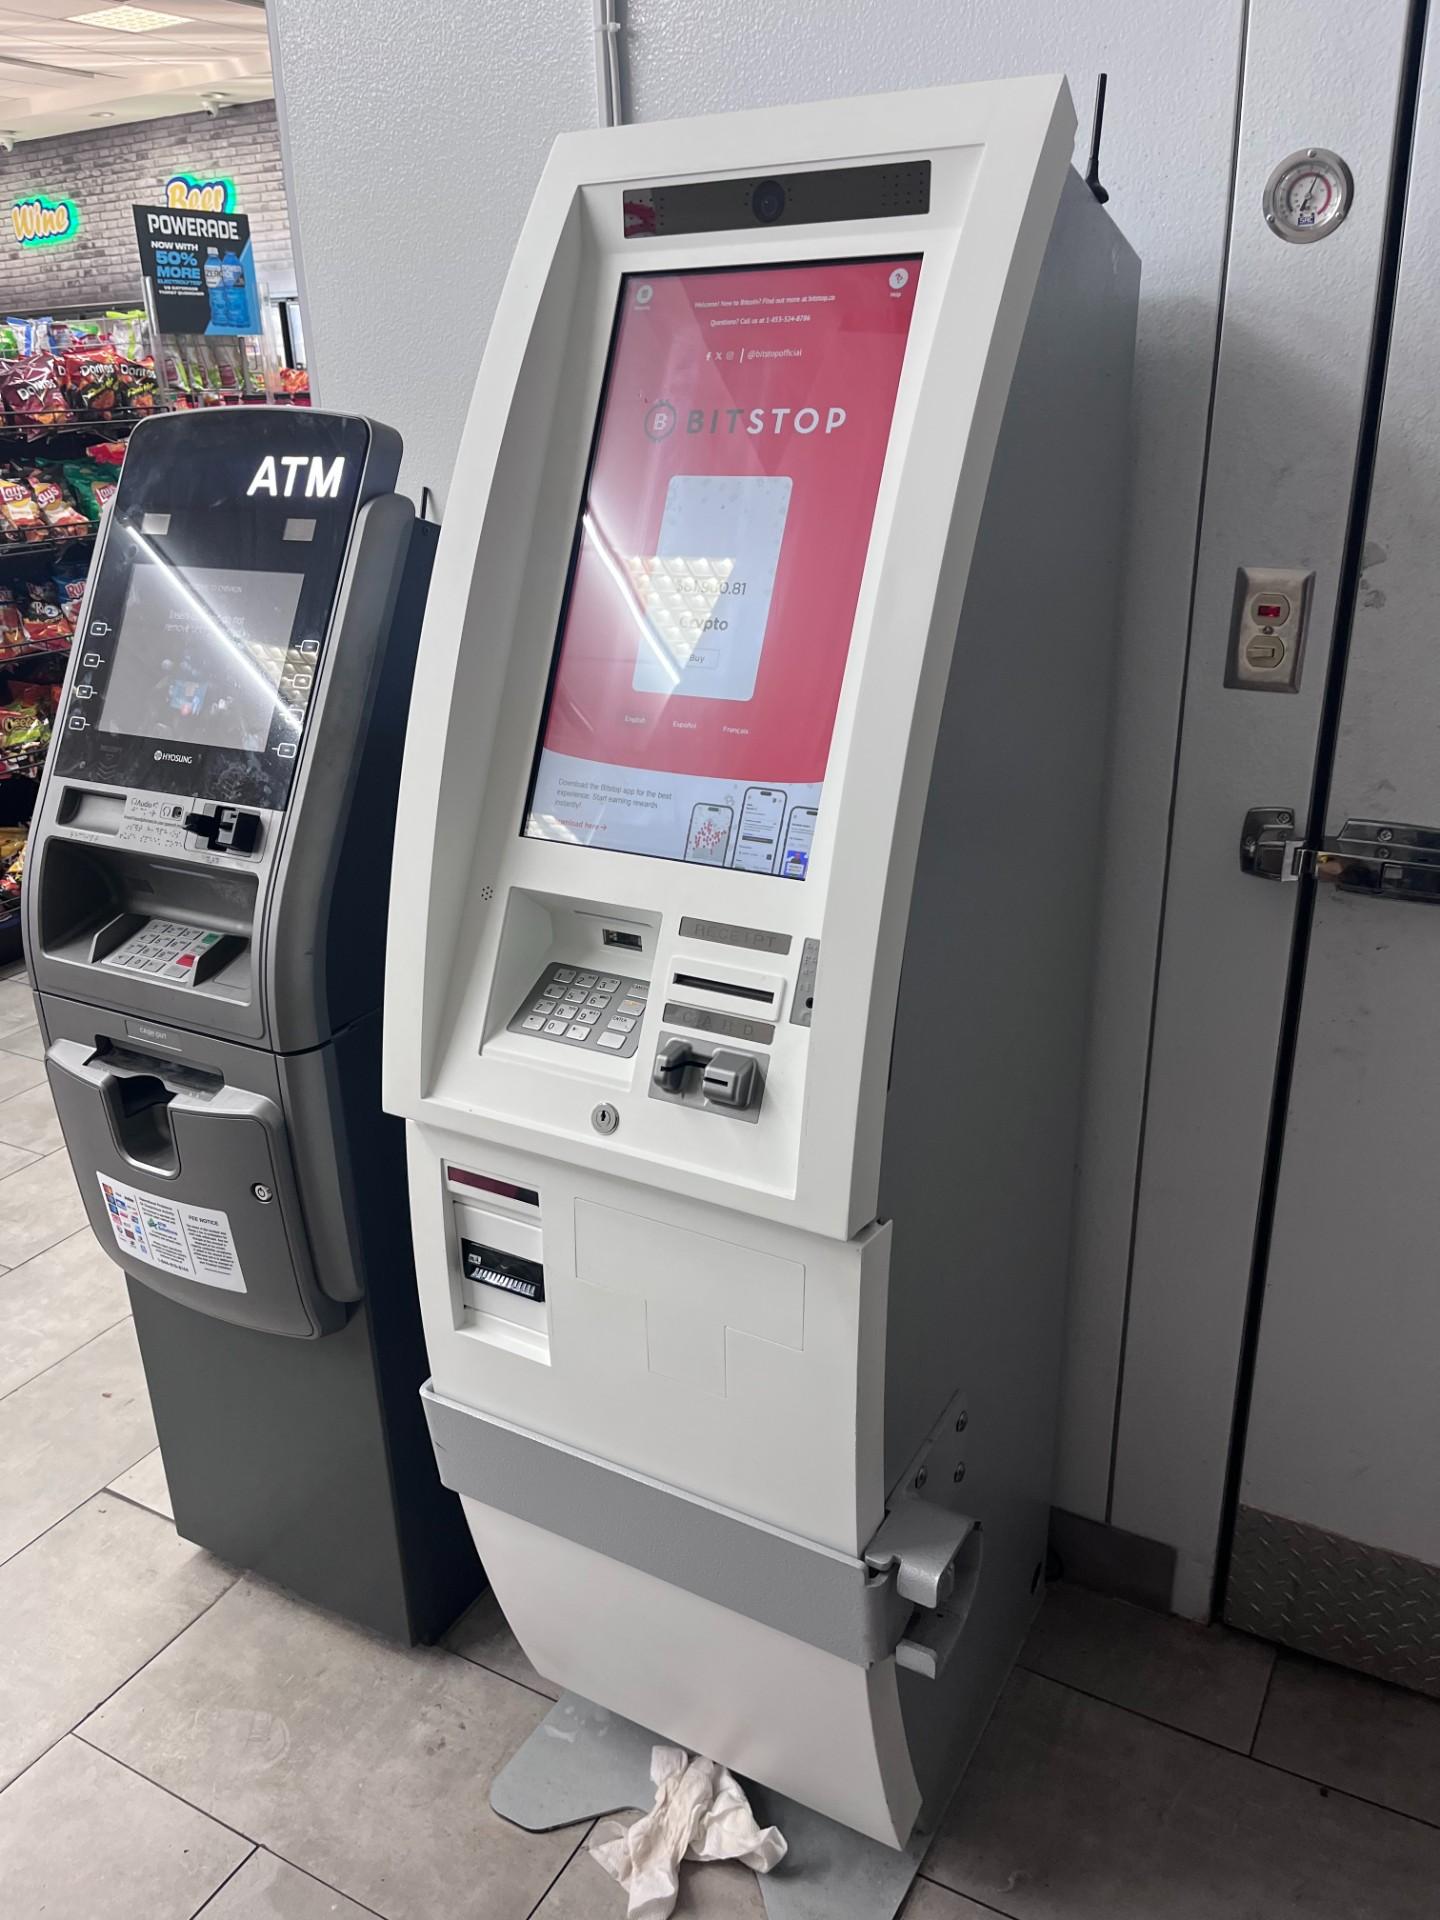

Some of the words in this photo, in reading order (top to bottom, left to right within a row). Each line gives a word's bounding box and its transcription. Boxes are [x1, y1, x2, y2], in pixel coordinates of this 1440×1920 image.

[167, 181, 224, 212] Beer
[12, 201, 69, 242] Wine
[147, 213, 239, 240] POWERADE
[150, 241, 174, 250] NOW
[174, 242, 199, 251] WITH
[155, 250, 198, 266] 50%
[156, 265, 201, 279] MORE
[80, 363, 115, 377] Doritos
[120, 363, 157, 379] Doritos
[686, 407, 846, 434] BITSTOP
[246, 455, 345, 498] ATM
[0, 485, 28, 501] Lay's
[37, 485, 60, 508] Lay's
[679, 616, 729, 632] Crypto
[689, 653, 705, 663] Buy
[162, 752, 193, 764] HYOSUNG
[695, 923, 777, 948] RECEIPT
[682, 1011, 754, 1036] CARD
[199, 1217, 219, 1227] NOTICE
